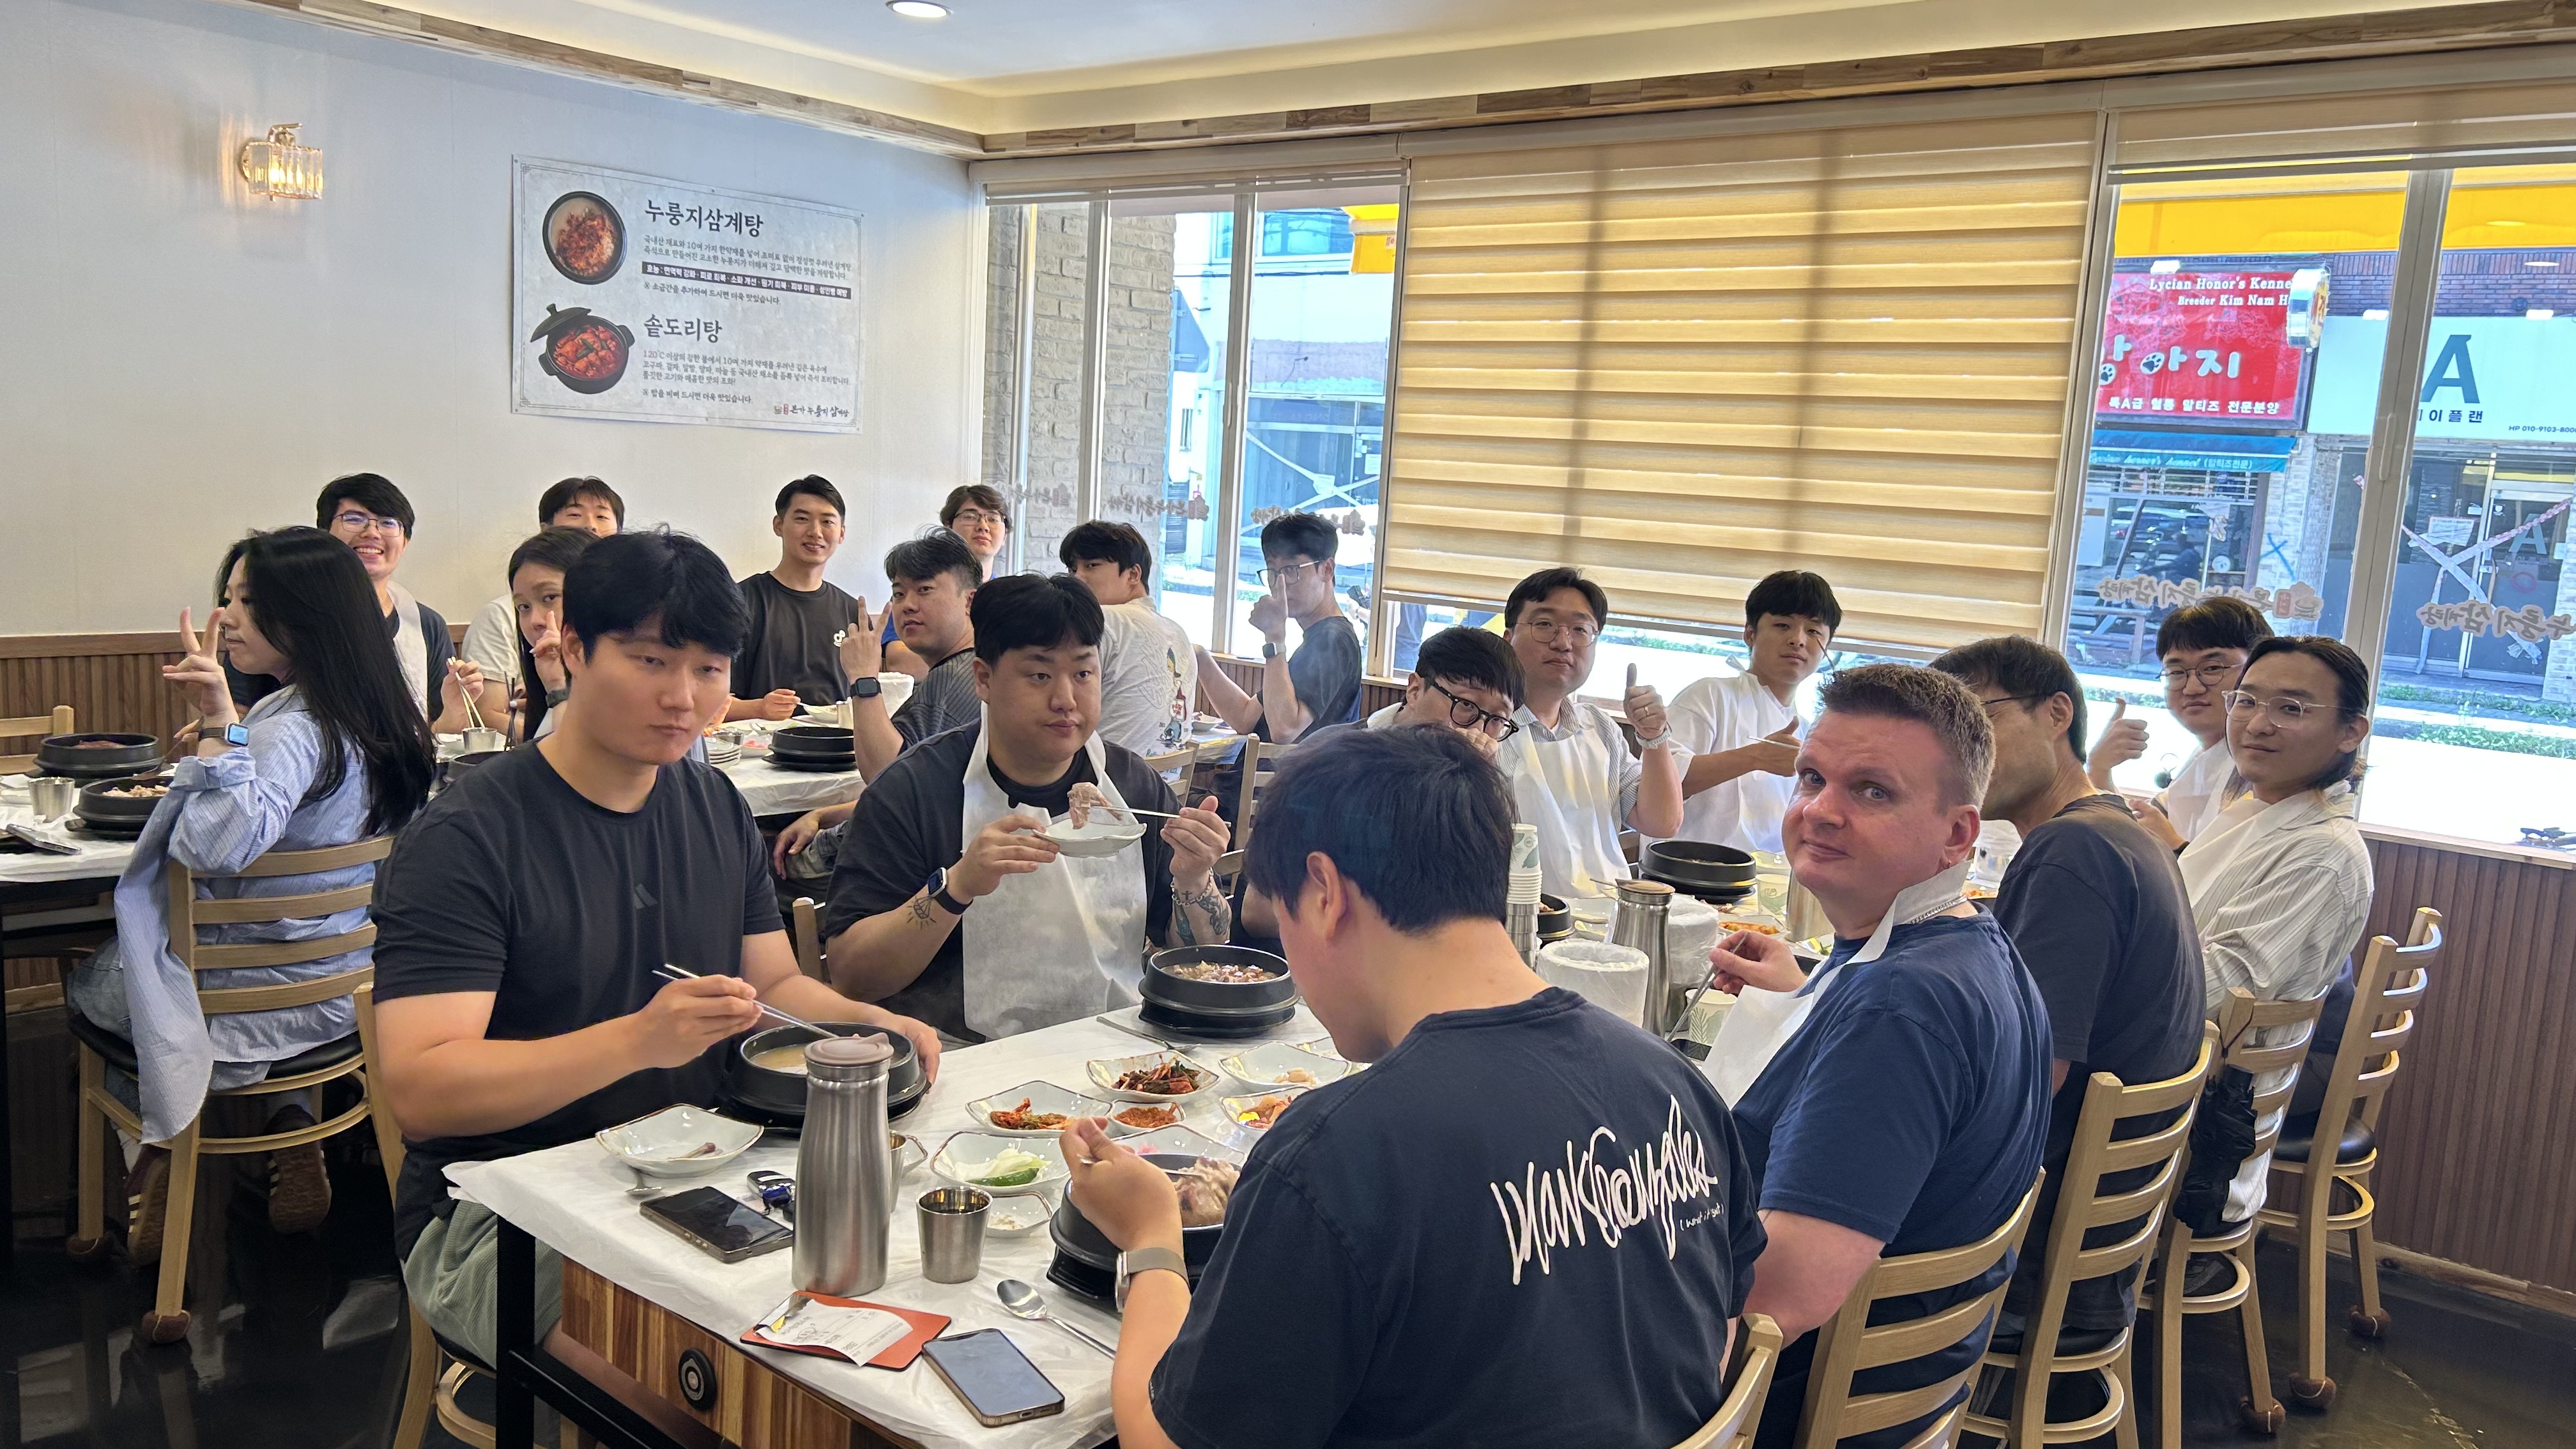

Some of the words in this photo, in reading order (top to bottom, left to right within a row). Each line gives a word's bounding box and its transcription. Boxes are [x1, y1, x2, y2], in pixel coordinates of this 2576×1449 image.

[645, 199, 764, 237] 누룽지삼계탕
[644, 234, 664, 246] 국내산
[666, 238, 685, 249] 재료와
[687, 241, 702, 251] 10여
[704, 243, 717, 252] 가지
[719, 245, 744, 257] 한약재를
[747, 249, 760, 259] 넣어
[761, 252, 780, 261] 조미료
[816, 259, 833, 269] 우려낸
[644, 245, 670, 256] 즉석으로
[672, 250, 698, 261] 만들어진
[699, 254, 719, 264] 고소한
[721, 256, 747, 267] 누룽지가
[748, 259, 768, 270] 더해져
[769, 263, 782, 272] 깊고
[783, 264, 802, 275] 담백한
[803, 266, 816, 277] 맛을
[664, 266, 682, 277] 면역력
[683, 269, 696, 279] 강화
[700, 272, 712, 280] 피로
[714, 273, 726, 282] 회복
[730, 275, 743, 284] 소화
[744, 277, 757, 286] 개선
[761, 279, 774, 288] 원기
[774, 280, 787, 289] 회복
[791, 282, 802, 291] 피부
[803, 284, 816, 293] 미용
[819, 286, 836, 295] 성인병
[836, 289, 847, 297] 예방
[2149, 279, 2191, 291] Lycian
[2196, 277, 2245, 290] Honor's
[2250, 277, 2292, 289] Kenne
[652, 283, 679, 294] 소금간을
[680, 286, 707, 296] 추가하여
[709, 289, 729, 299] 드시면
[731, 292, 744, 301] 더욱
[2178, 296, 2216, 305] Breeder
[2219, 295, 2243, 305] Kim
[2247, 295, 2274, 305] Nam
[2278, 295, 2291, 305] H
[644, 313, 723, 344] 솥도리탕
[666, 352, 686, 362] 이상의
[687, 354, 700, 363] 강한
[702, 355, 721, 365] 불에서
[723, 357, 739, 366] 10여
[740, 358, 753, 367] 가지
[755, 360, 774, 369] 약재를
[776, 362, 794, 371] 우려낸
[796, 364, 808, 372] 깊은
[810, 364, 827, 374] 육수에
[2419, 335, 2480, 404] A
[643, 371, 663, 380] 쫄깃한
[664, 372, 683, 382] 고기와
[685, 374, 705, 384] 매콤한
[706, 376, 719, 385] 맛의
[716, 367, 728, 376] 마늘
[730, 368, 737, 376] 등
[739, 369, 758, 378] 국내산
[760, 370, 778, 379] 채소를
[780, 372, 793, 381] 듬뿍
[793, 373, 806, 382] 넣어
[808, 374, 820, 383] 즉석
[651, 389, 664, 398] 밥을
[666, 390, 680, 399] 비벼
[680, 392, 701, 401] 드시면
[702, 393, 716, 402] 더욱
[2182, 399, 2220, 412] 말티즈
[2228, 401, 2280, 415] 전문분양
[2522, 425, 2576, 434] 010-9103-800
